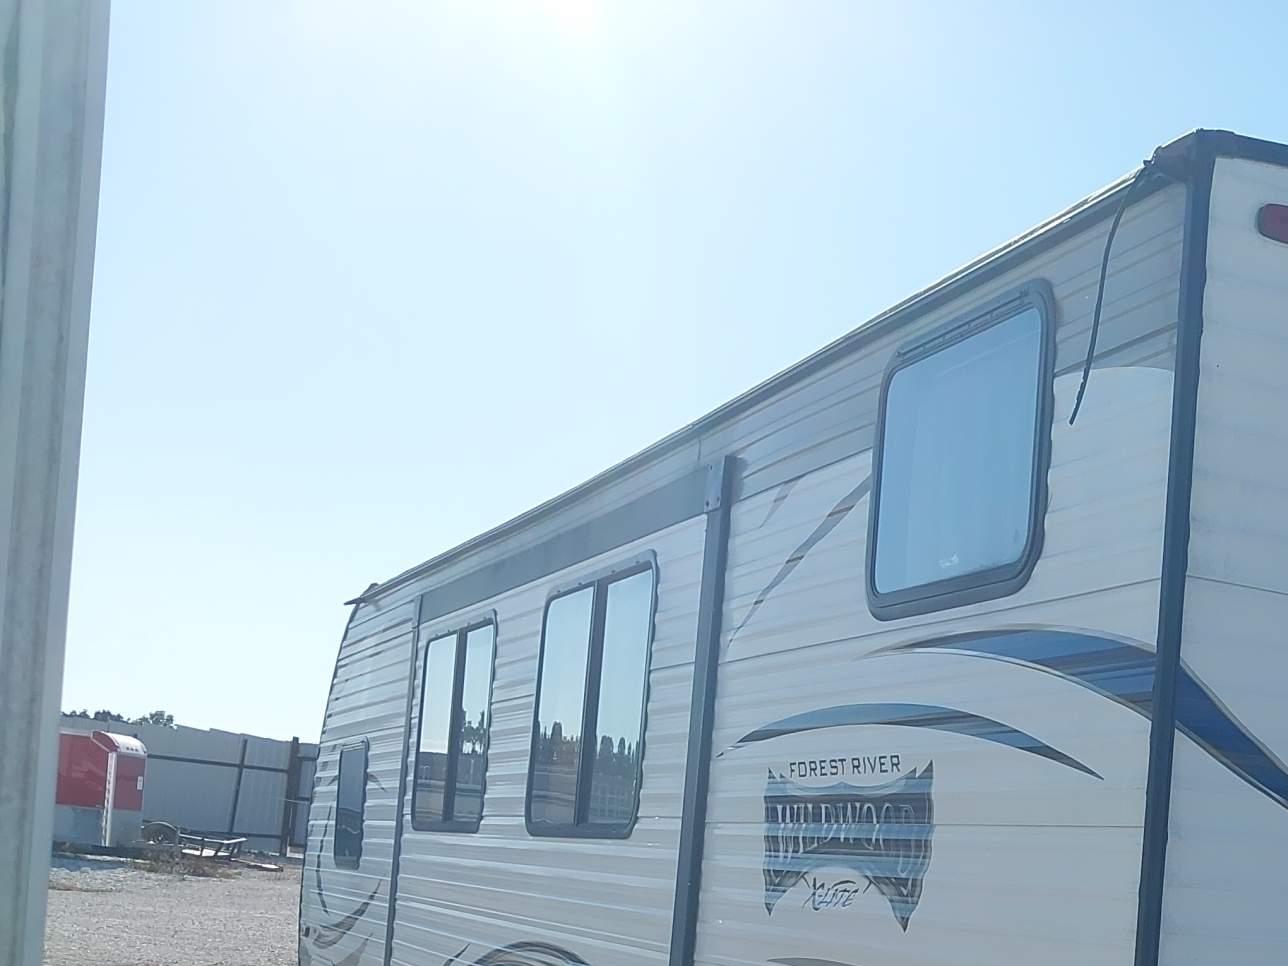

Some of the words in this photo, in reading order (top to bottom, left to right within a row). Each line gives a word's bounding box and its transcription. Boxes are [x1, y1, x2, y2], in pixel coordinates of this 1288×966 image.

[789, 758, 847, 779] FOREST
[852, 754, 901, 775] RIVER
[776, 801, 915, 875] WILDWOOD
